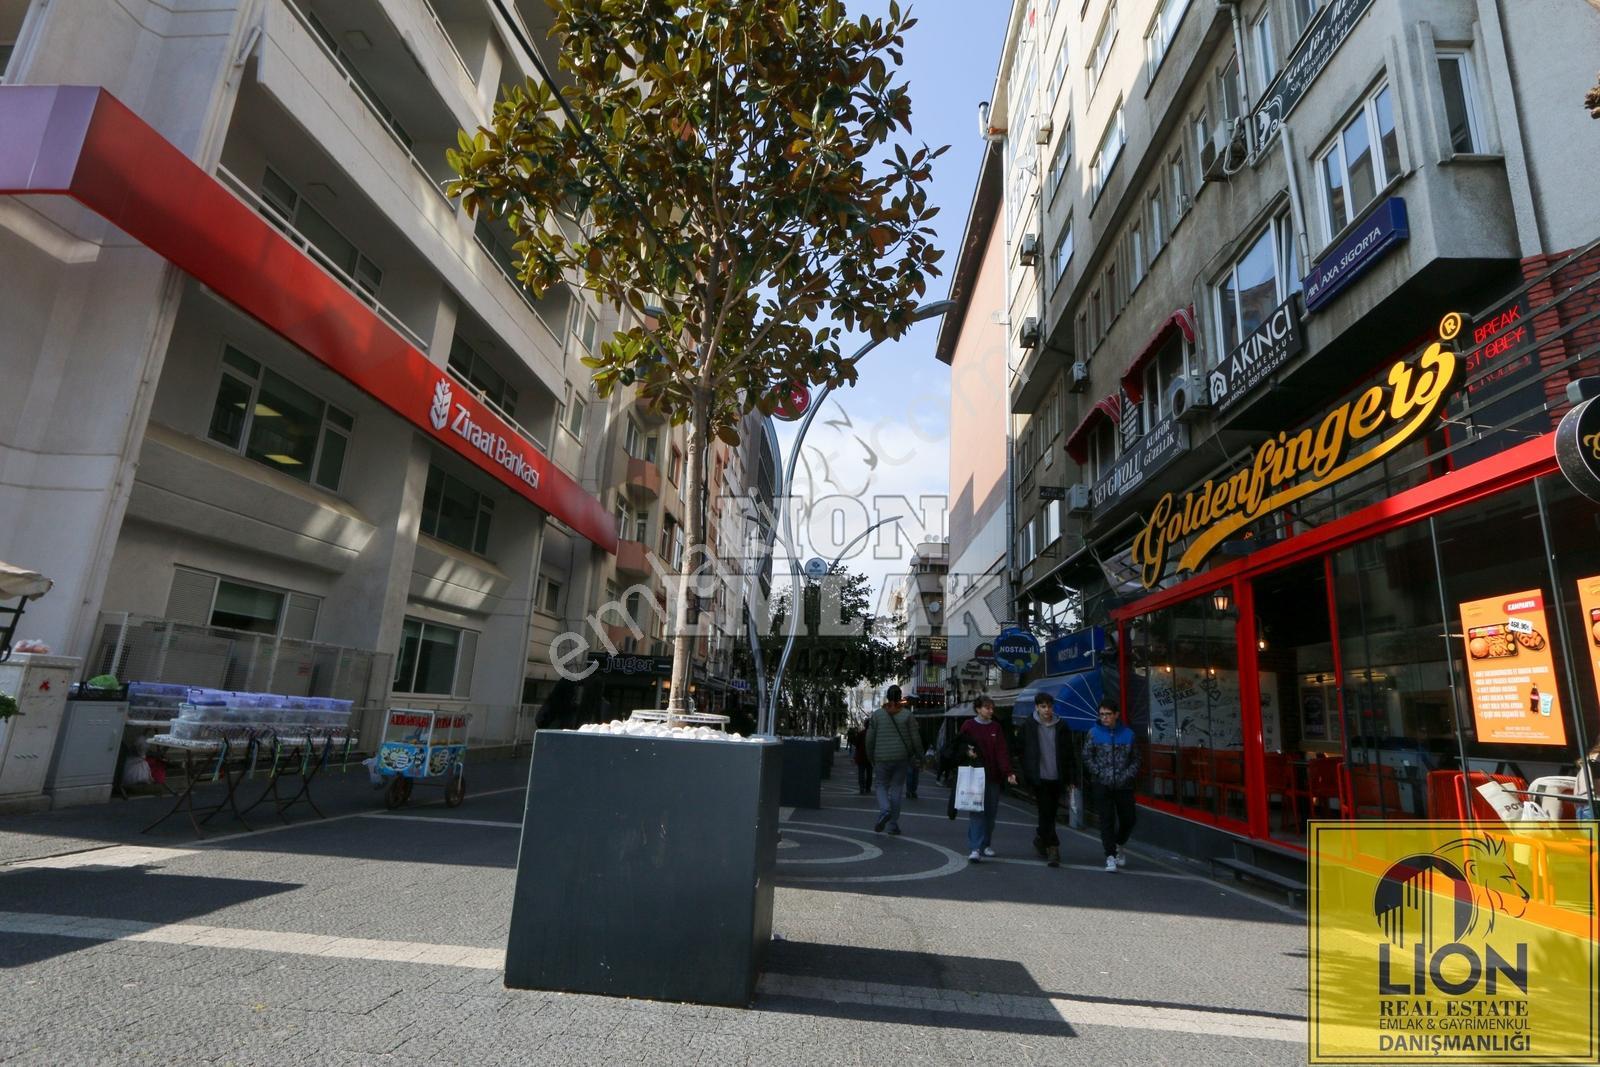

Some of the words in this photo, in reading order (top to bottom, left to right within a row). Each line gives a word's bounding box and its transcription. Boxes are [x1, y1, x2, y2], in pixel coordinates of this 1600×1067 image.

[1321, 265, 1340, 288] AXA
[1230, 304, 1293, 382] AKINCI
[1473, 304, 1521, 344] BREAK
[450, 403, 496, 459] Ziraat
[494, 435, 540, 489] Bankası
[1131, 342, 1456, 589] Goldenfingers
